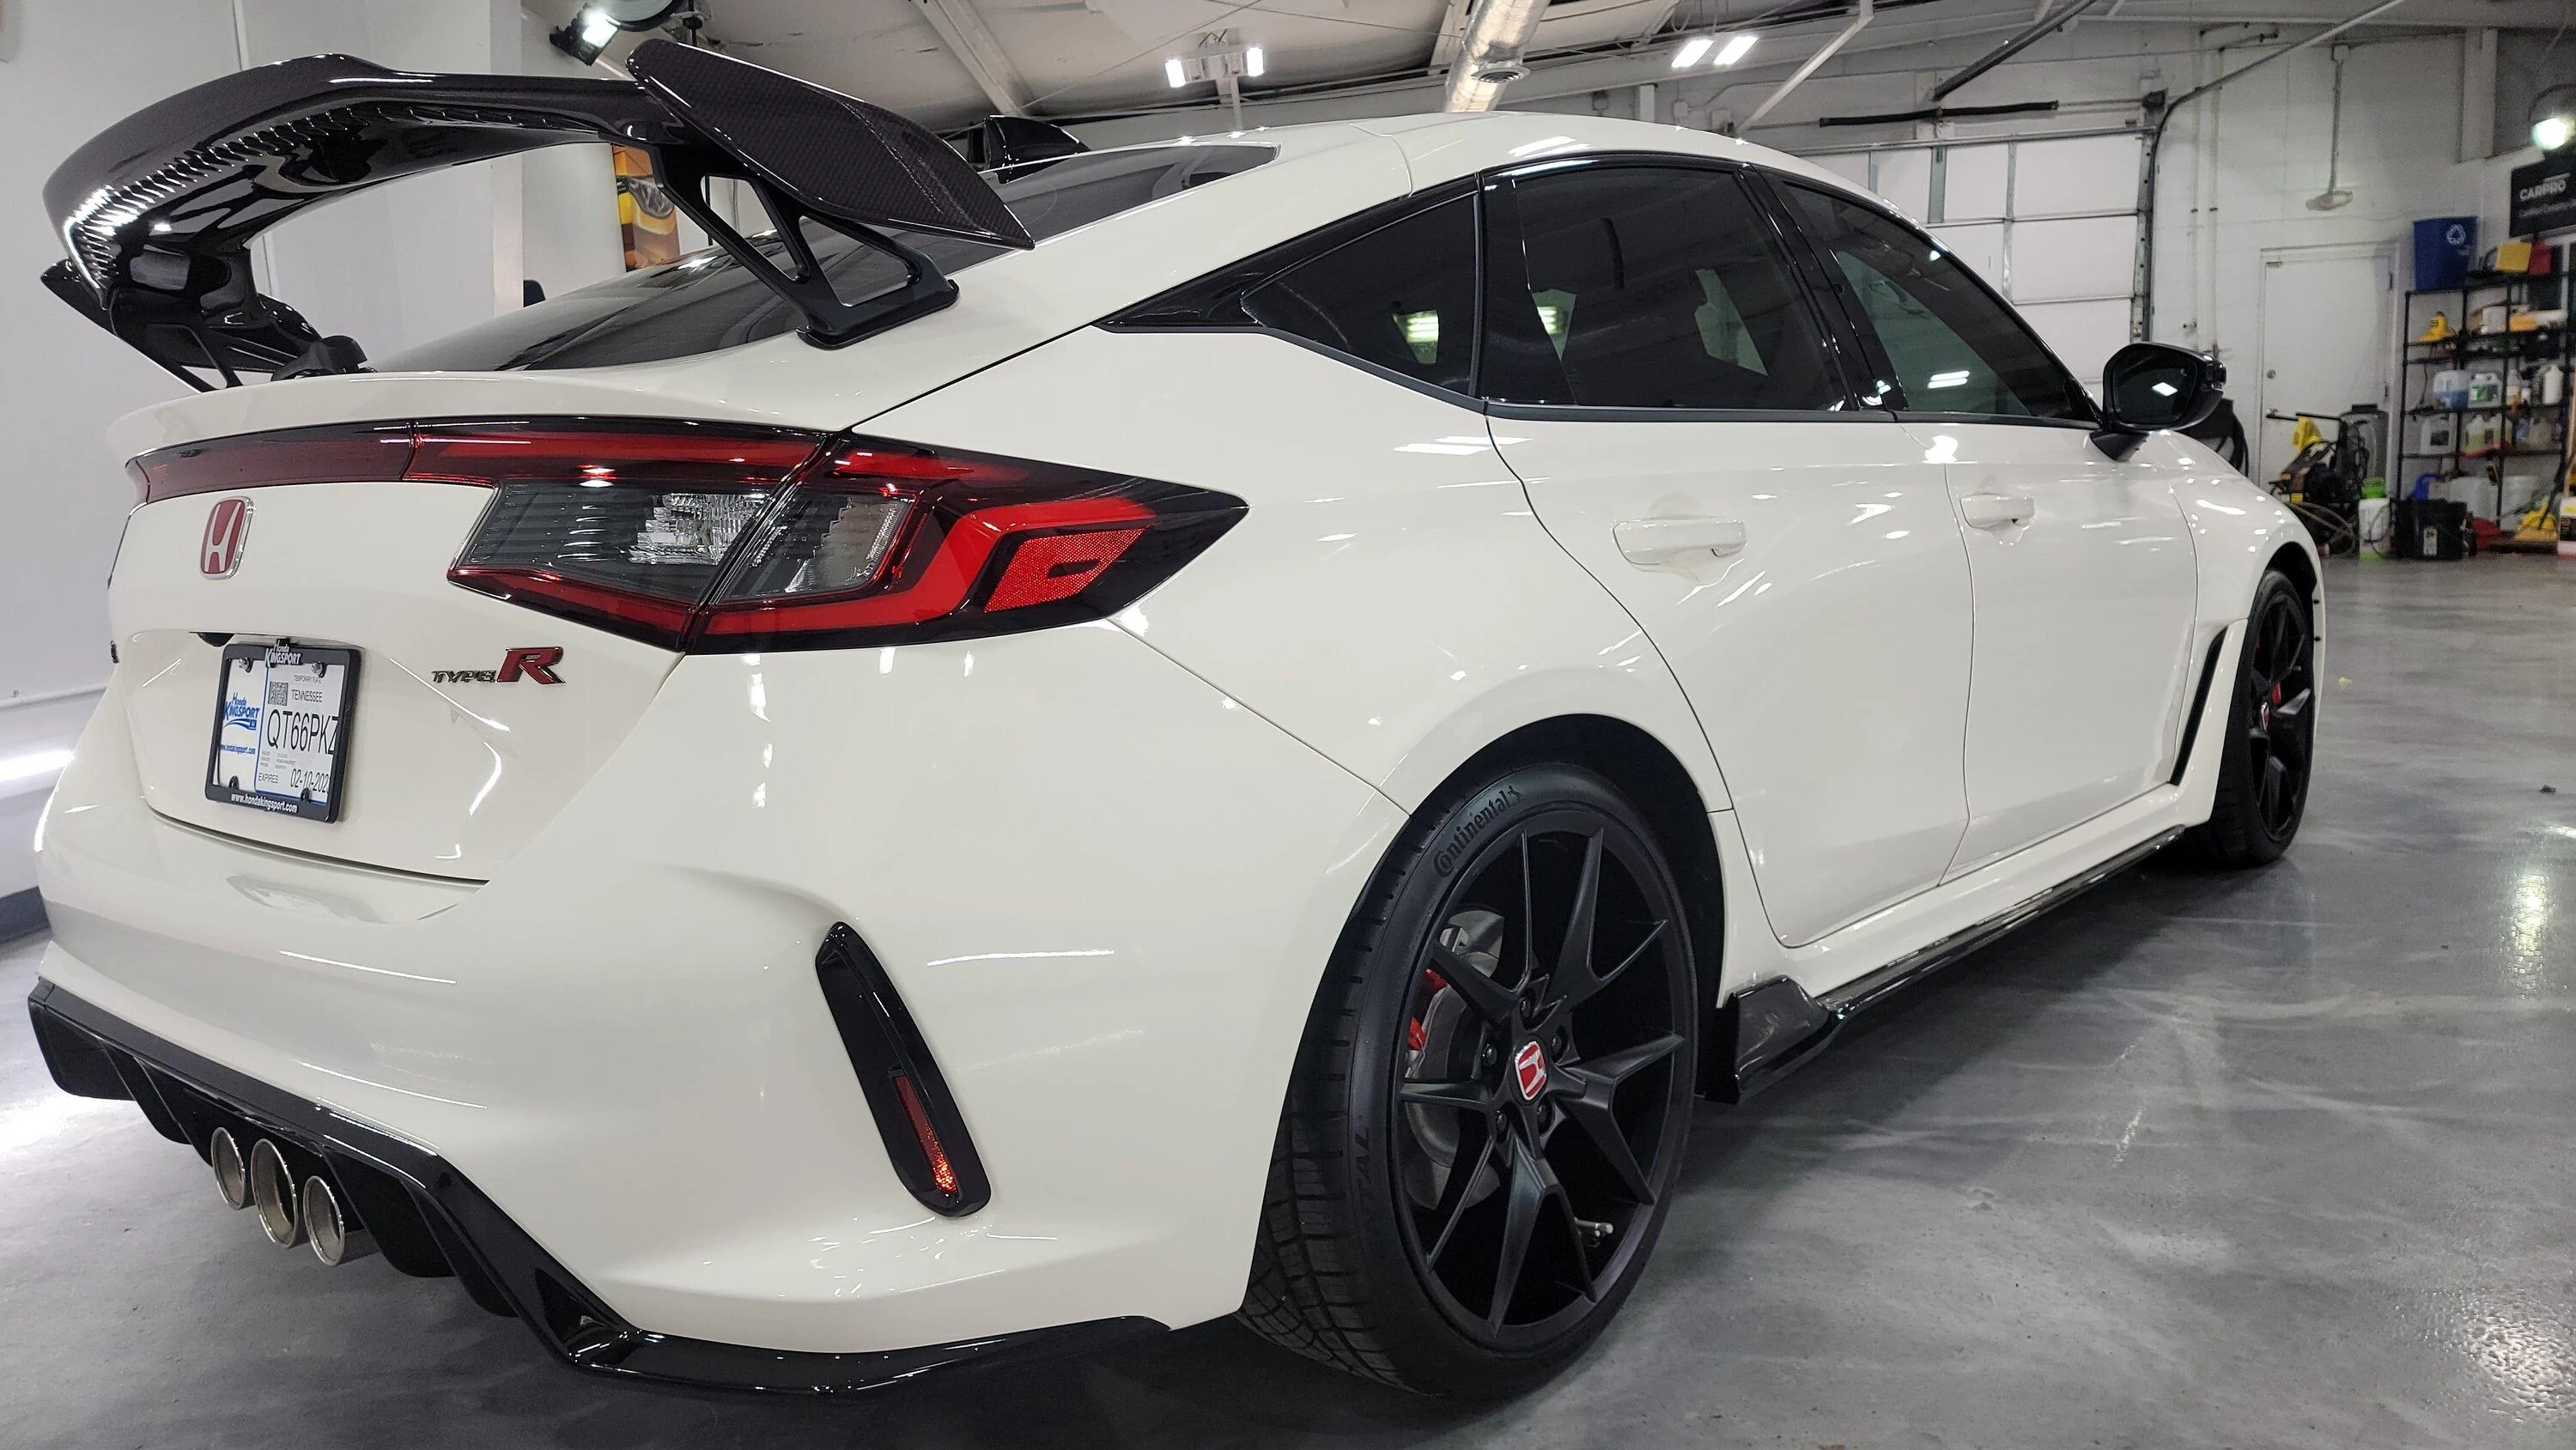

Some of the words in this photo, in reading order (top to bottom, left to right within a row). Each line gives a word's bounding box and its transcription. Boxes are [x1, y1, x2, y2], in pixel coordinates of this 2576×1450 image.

[431, 670, 496, 683] TYPE
[496, 646, 566, 685] R
[291, 689, 323, 703] TENNESSEE
[290, 767, 330, 794] 02-10-202
[231, 792, 299, 814] www.hondakingsport.com
[1433, 789, 1511, 877] Continental
